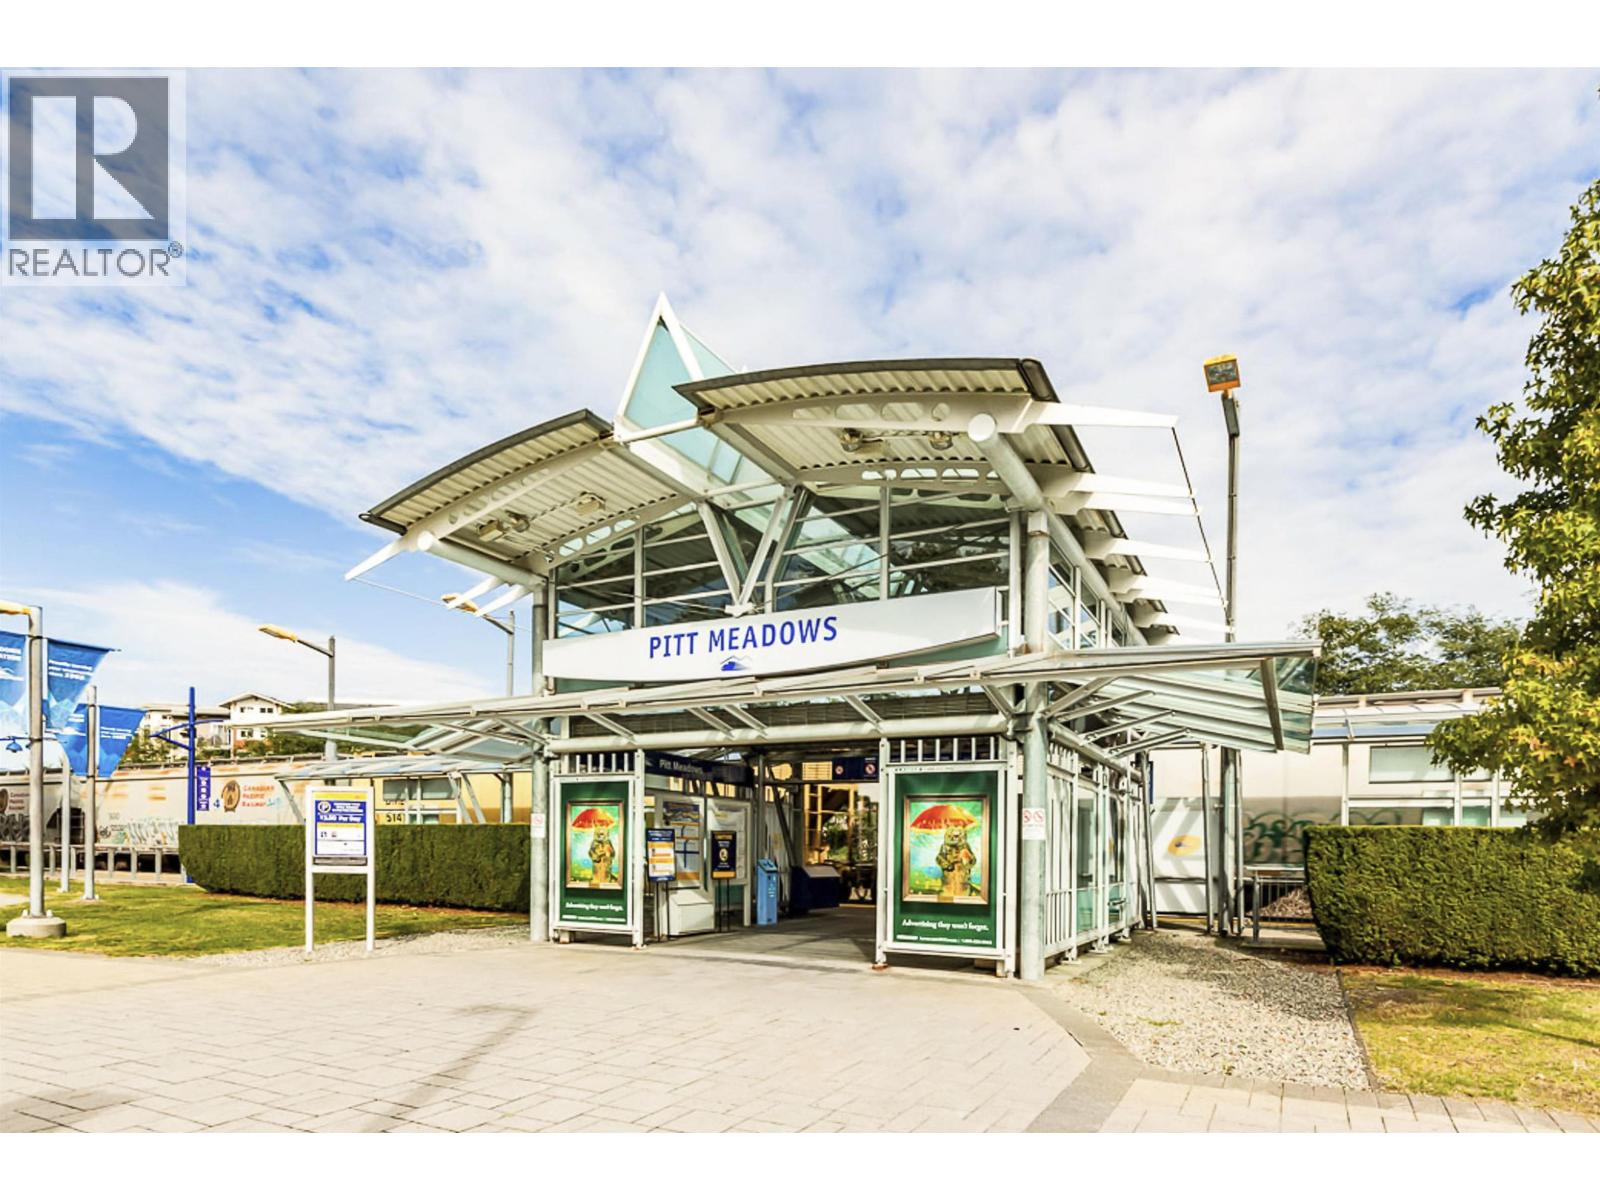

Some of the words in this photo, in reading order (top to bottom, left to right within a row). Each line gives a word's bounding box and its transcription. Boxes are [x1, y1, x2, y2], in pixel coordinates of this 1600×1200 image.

[649, 632, 699, 658] PITT
[708, 616, 838, 653] MEADOWS
[659, 759, 672, 769] Pitt
[902, 918, 937, 929] Advertising
[938, 920, 951, 930] they
